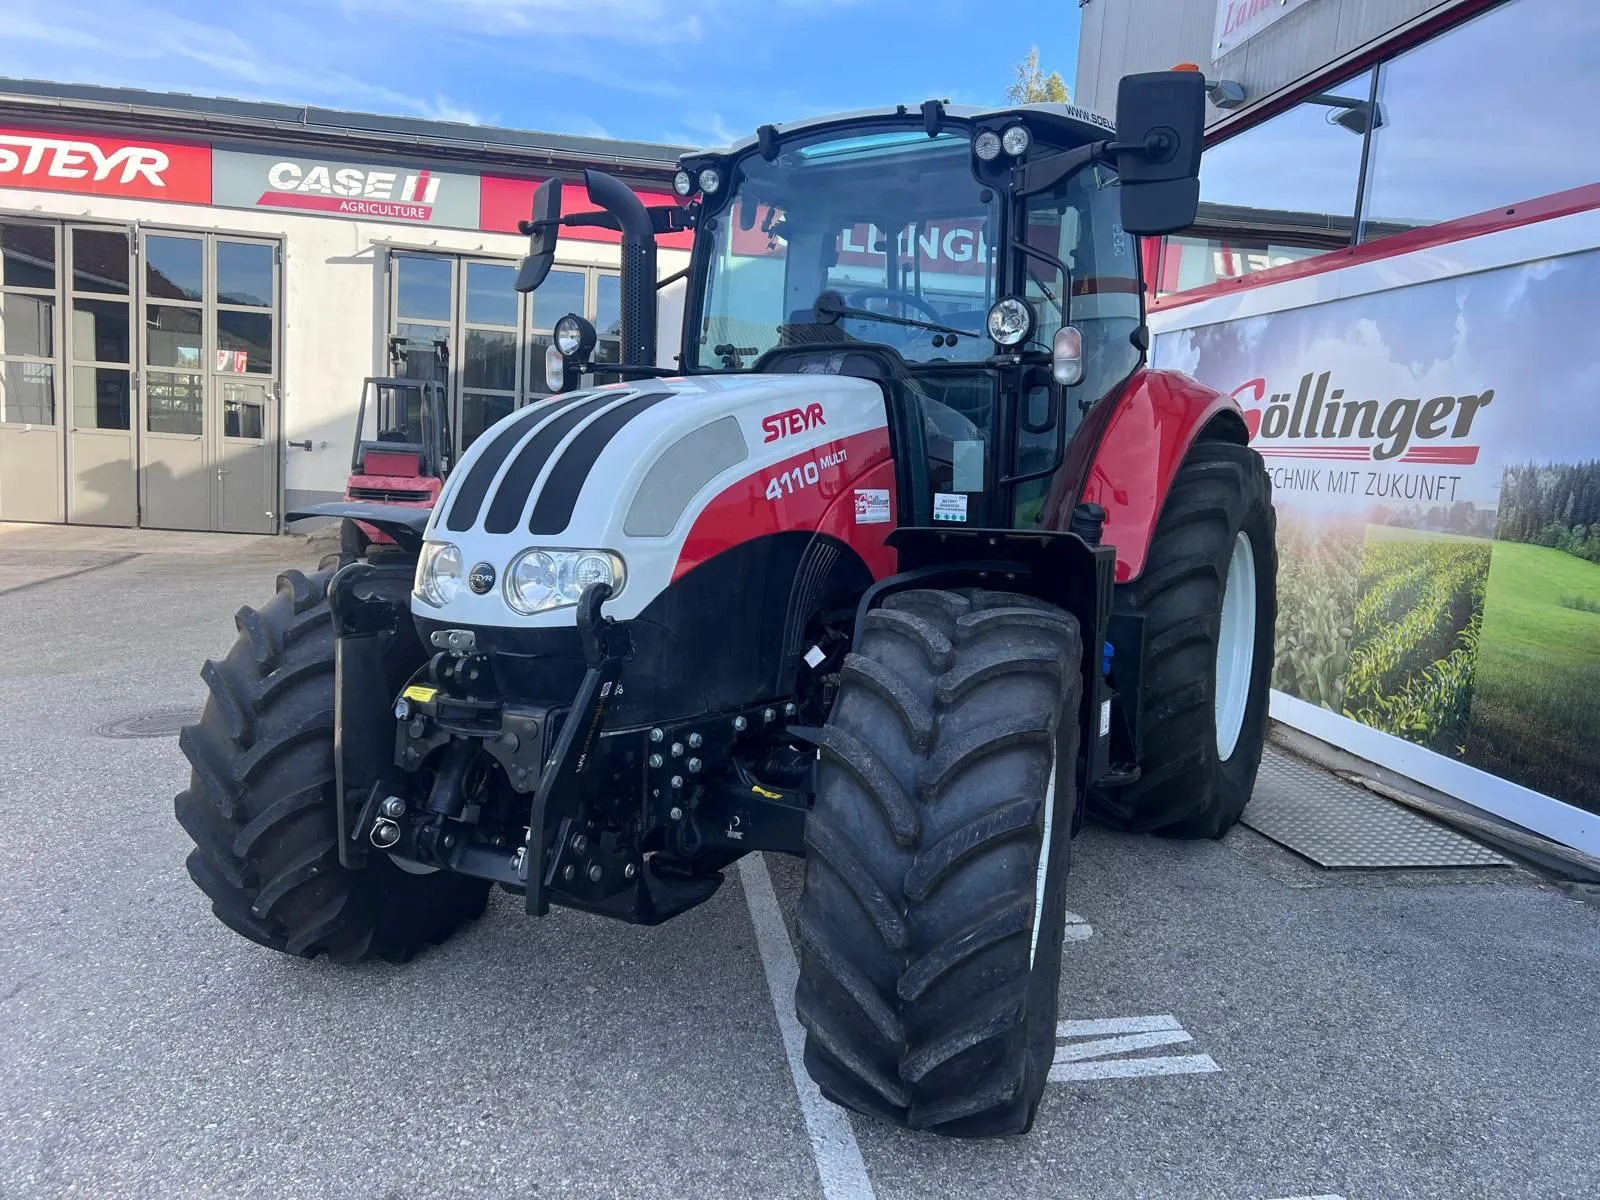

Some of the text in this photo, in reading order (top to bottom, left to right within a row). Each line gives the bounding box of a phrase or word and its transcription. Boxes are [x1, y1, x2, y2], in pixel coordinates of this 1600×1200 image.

[1065, 104, 1117, 131] WWW.SOELL
[268, 162, 397, 200] CASE
[339, 201, 426, 219] AGRICULTURE
[762, 402, 826, 444] STEYR
[765, 449, 848, 501] 4110 MULTI
[1264, 467, 1462, 503] CHNIK MIT ZUKUNFT
[470, 574, 493, 582] STEYR
